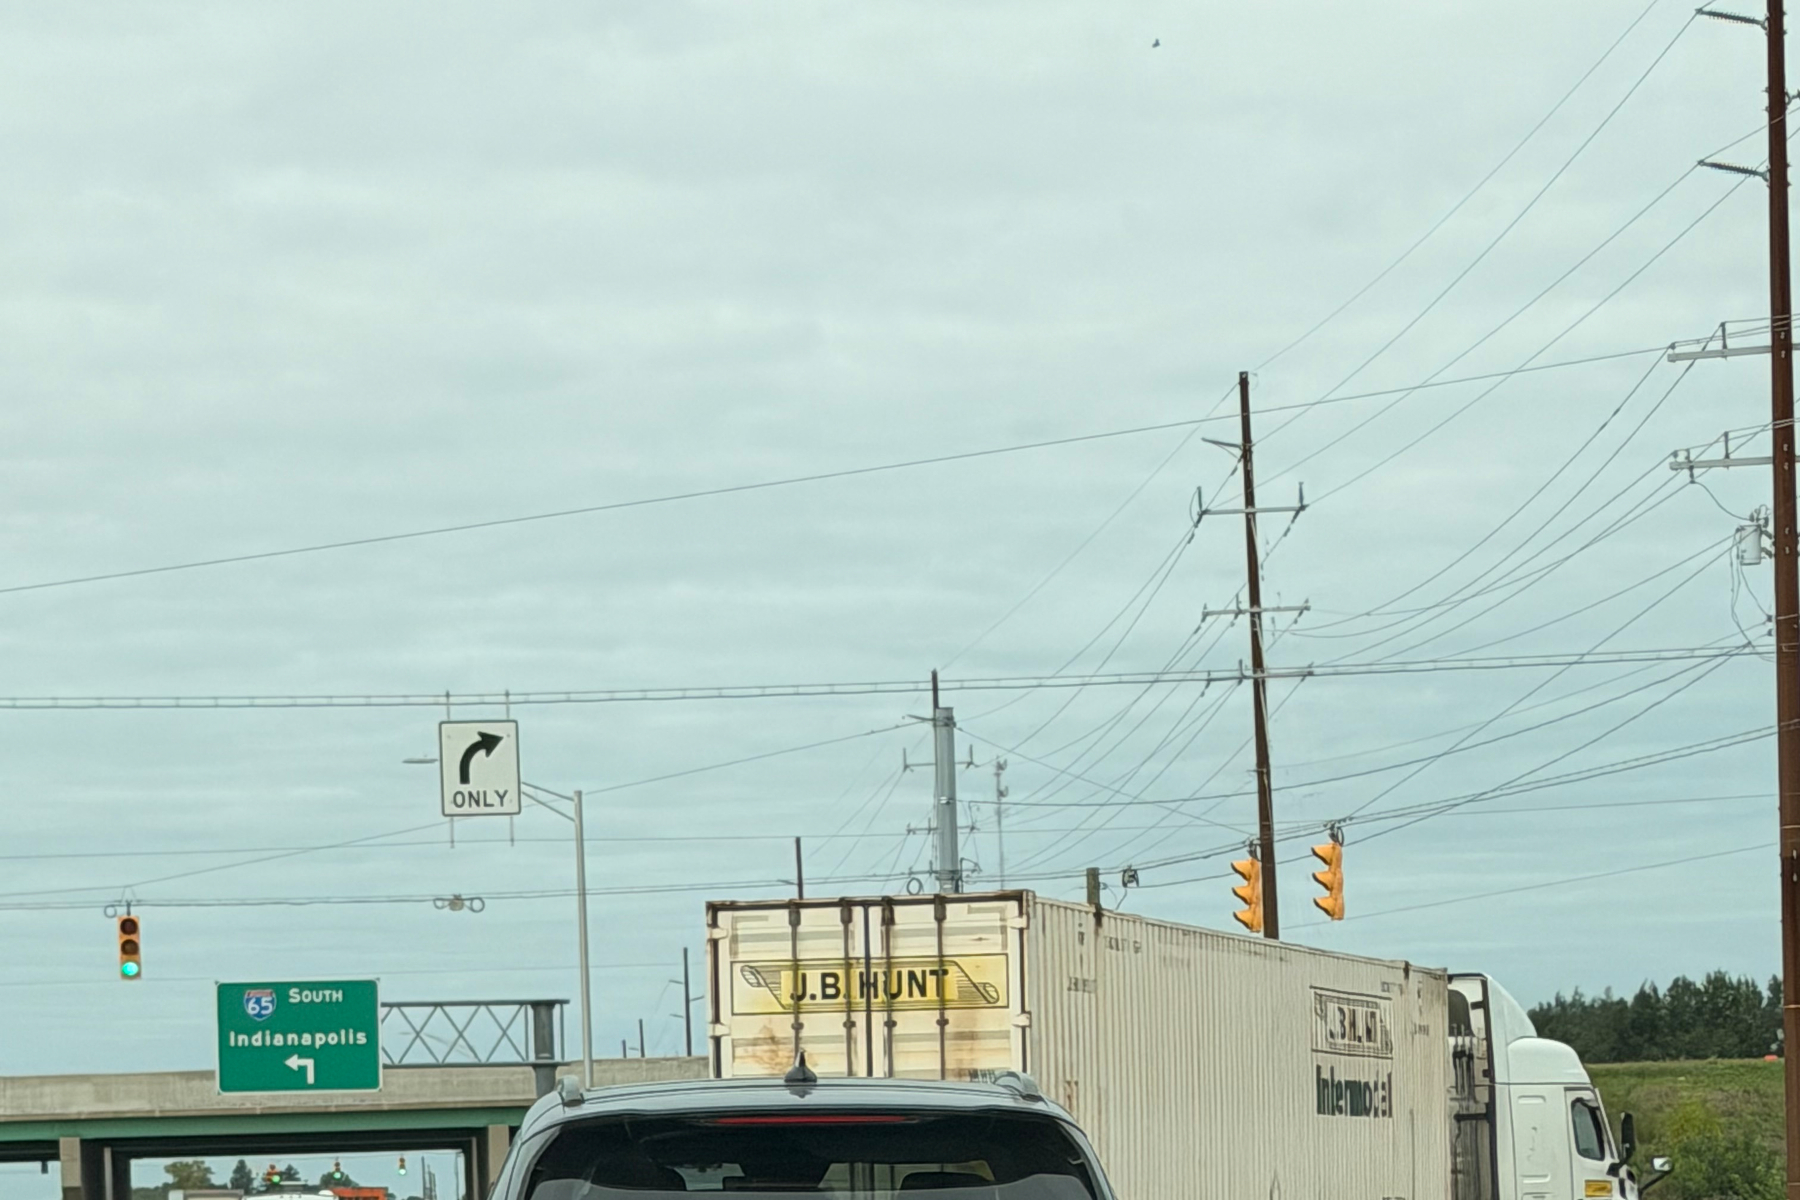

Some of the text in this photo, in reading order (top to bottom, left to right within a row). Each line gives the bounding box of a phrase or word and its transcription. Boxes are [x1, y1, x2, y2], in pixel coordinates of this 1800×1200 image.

[453, 789, 508, 808] ONLY
[859, 969, 949, 1000] HUNT
[247, 997, 273, 1015] 65
[229, 1028, 367, 1050] Indianapolis
